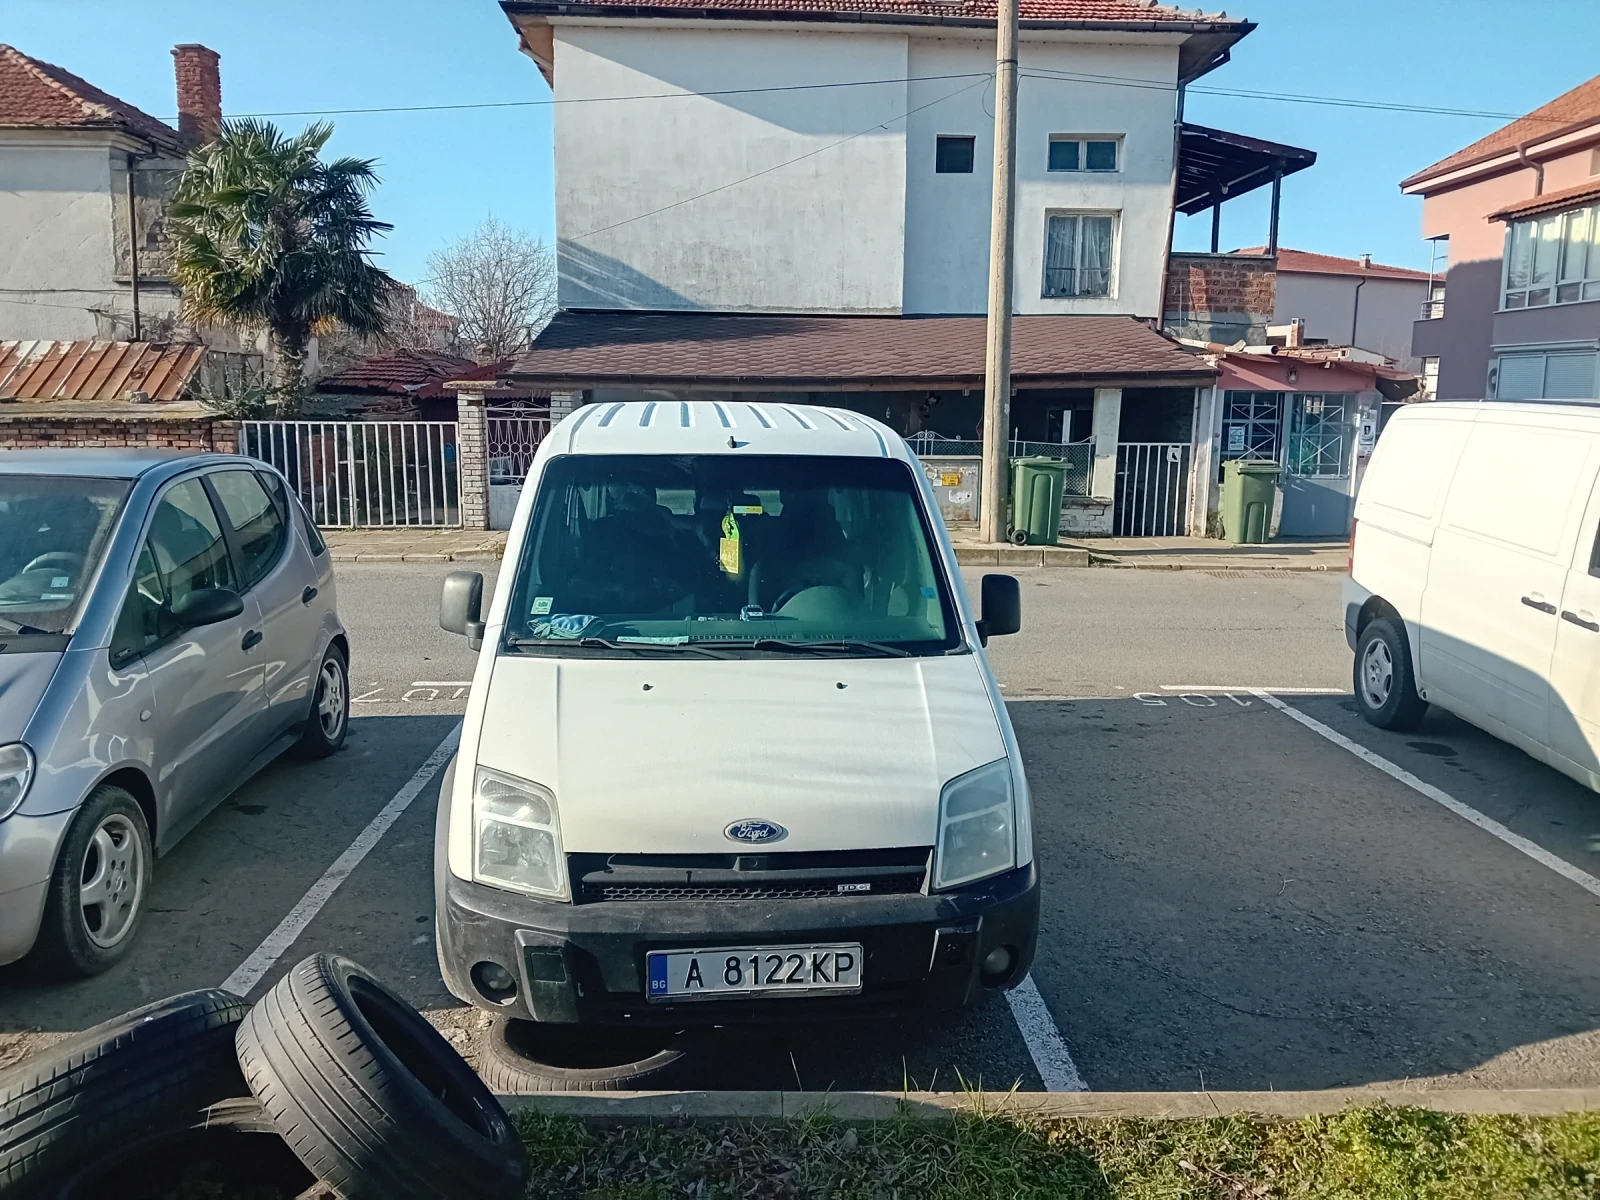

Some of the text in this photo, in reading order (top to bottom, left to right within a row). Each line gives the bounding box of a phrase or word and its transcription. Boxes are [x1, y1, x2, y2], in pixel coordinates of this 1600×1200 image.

[1133, 692, 1252, 706] 105
[737, 821, 770, 840] Ford
[684, 958, 704, 988] A
[651, 980, 666, 990] BG
